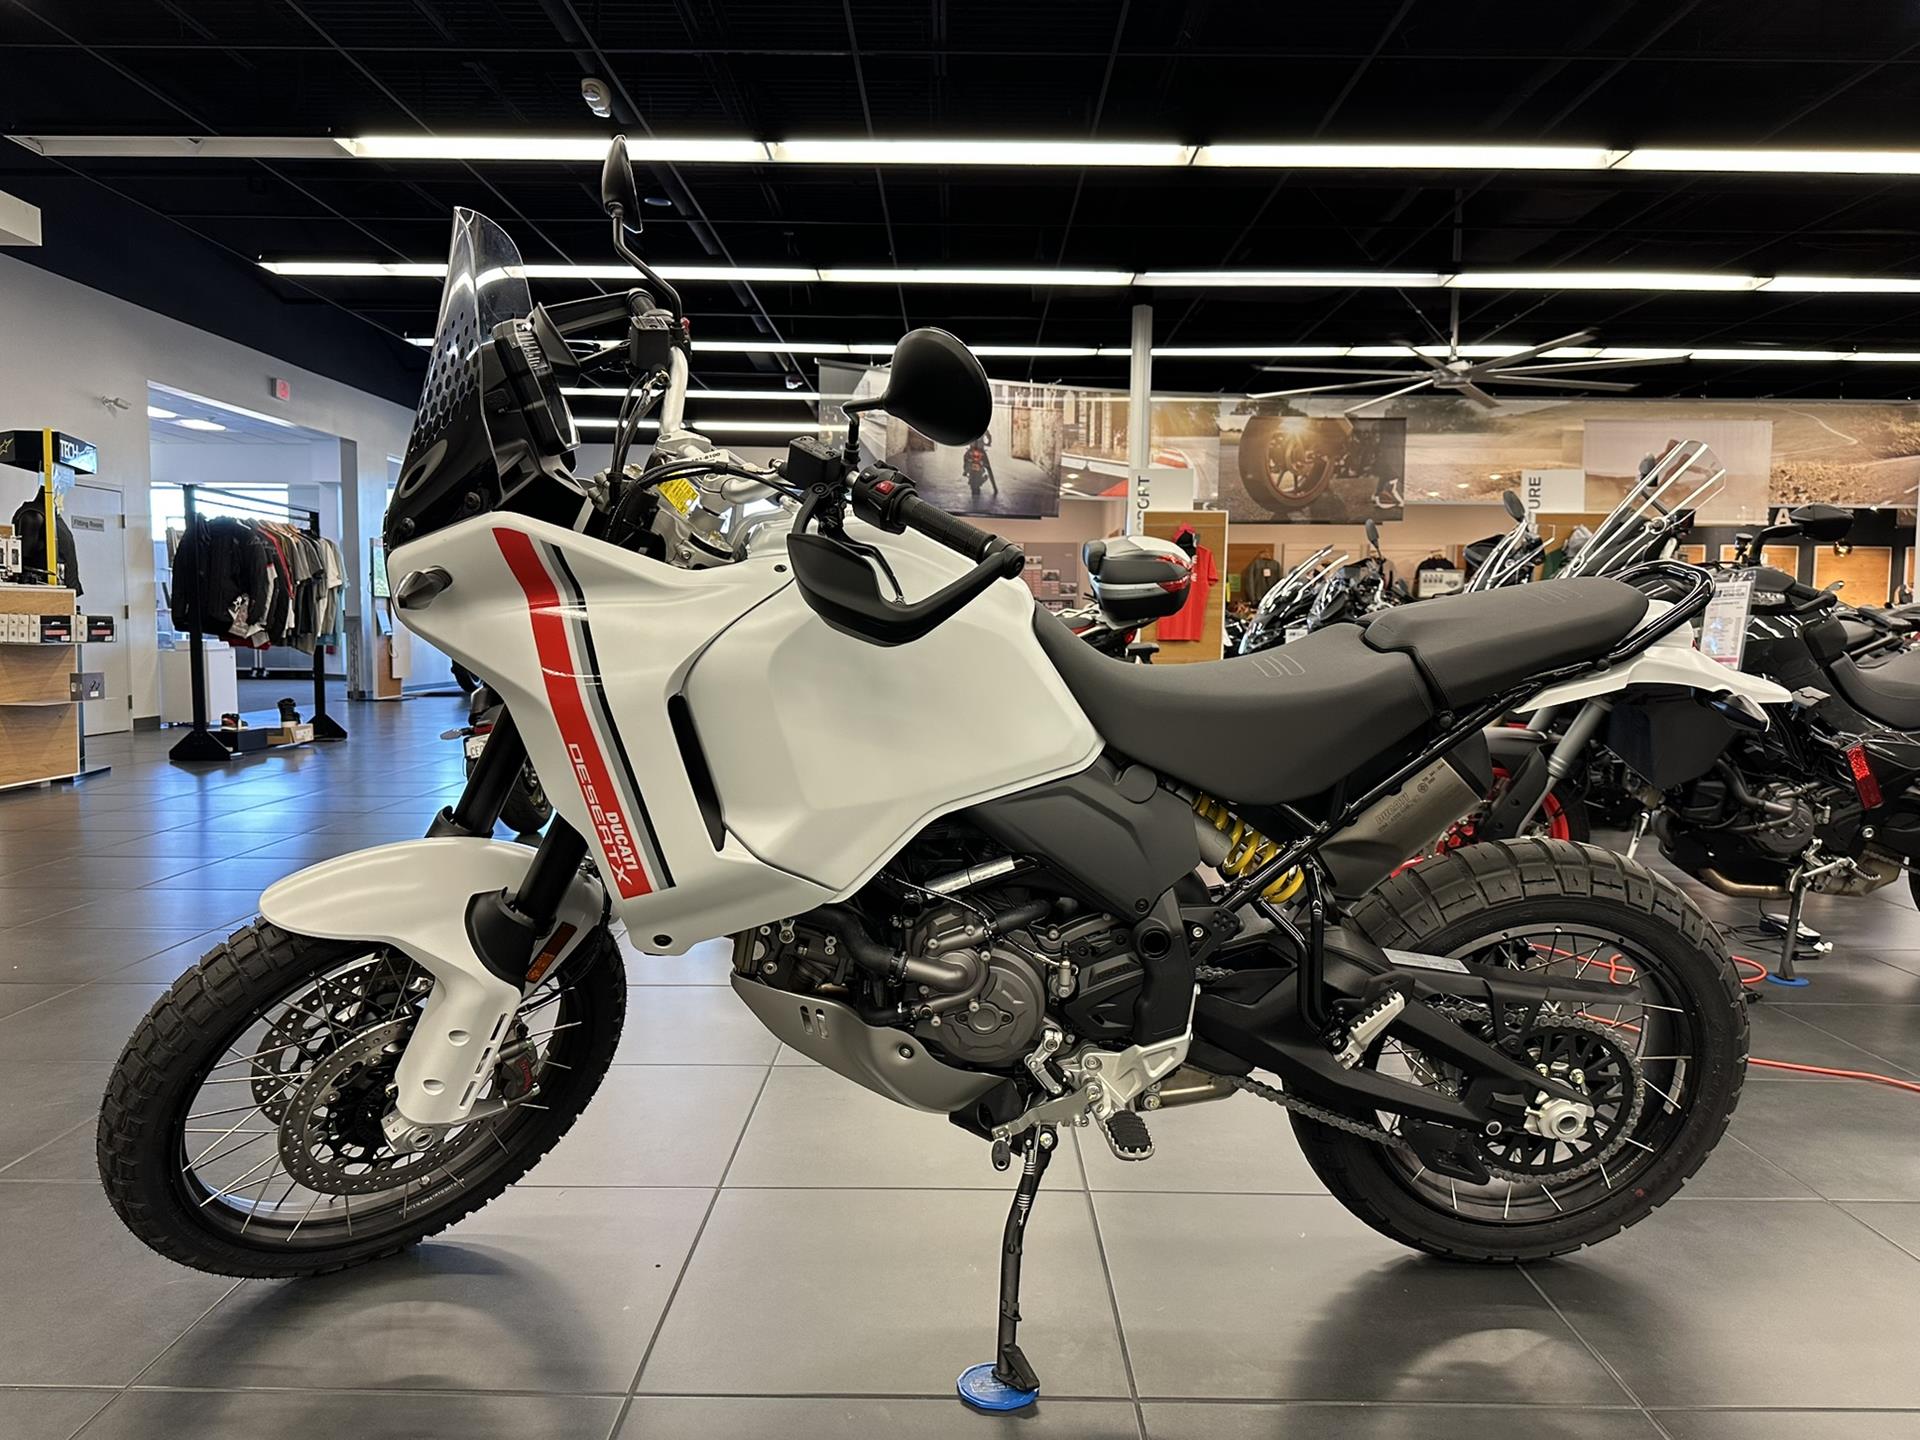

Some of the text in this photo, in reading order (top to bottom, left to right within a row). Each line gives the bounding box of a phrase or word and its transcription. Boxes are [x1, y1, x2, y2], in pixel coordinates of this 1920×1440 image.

[1528, 476, 1541, 516] URE
[568, 743, 633, 886] DESERTX
[605, 811, 639, 870] DUCATI
